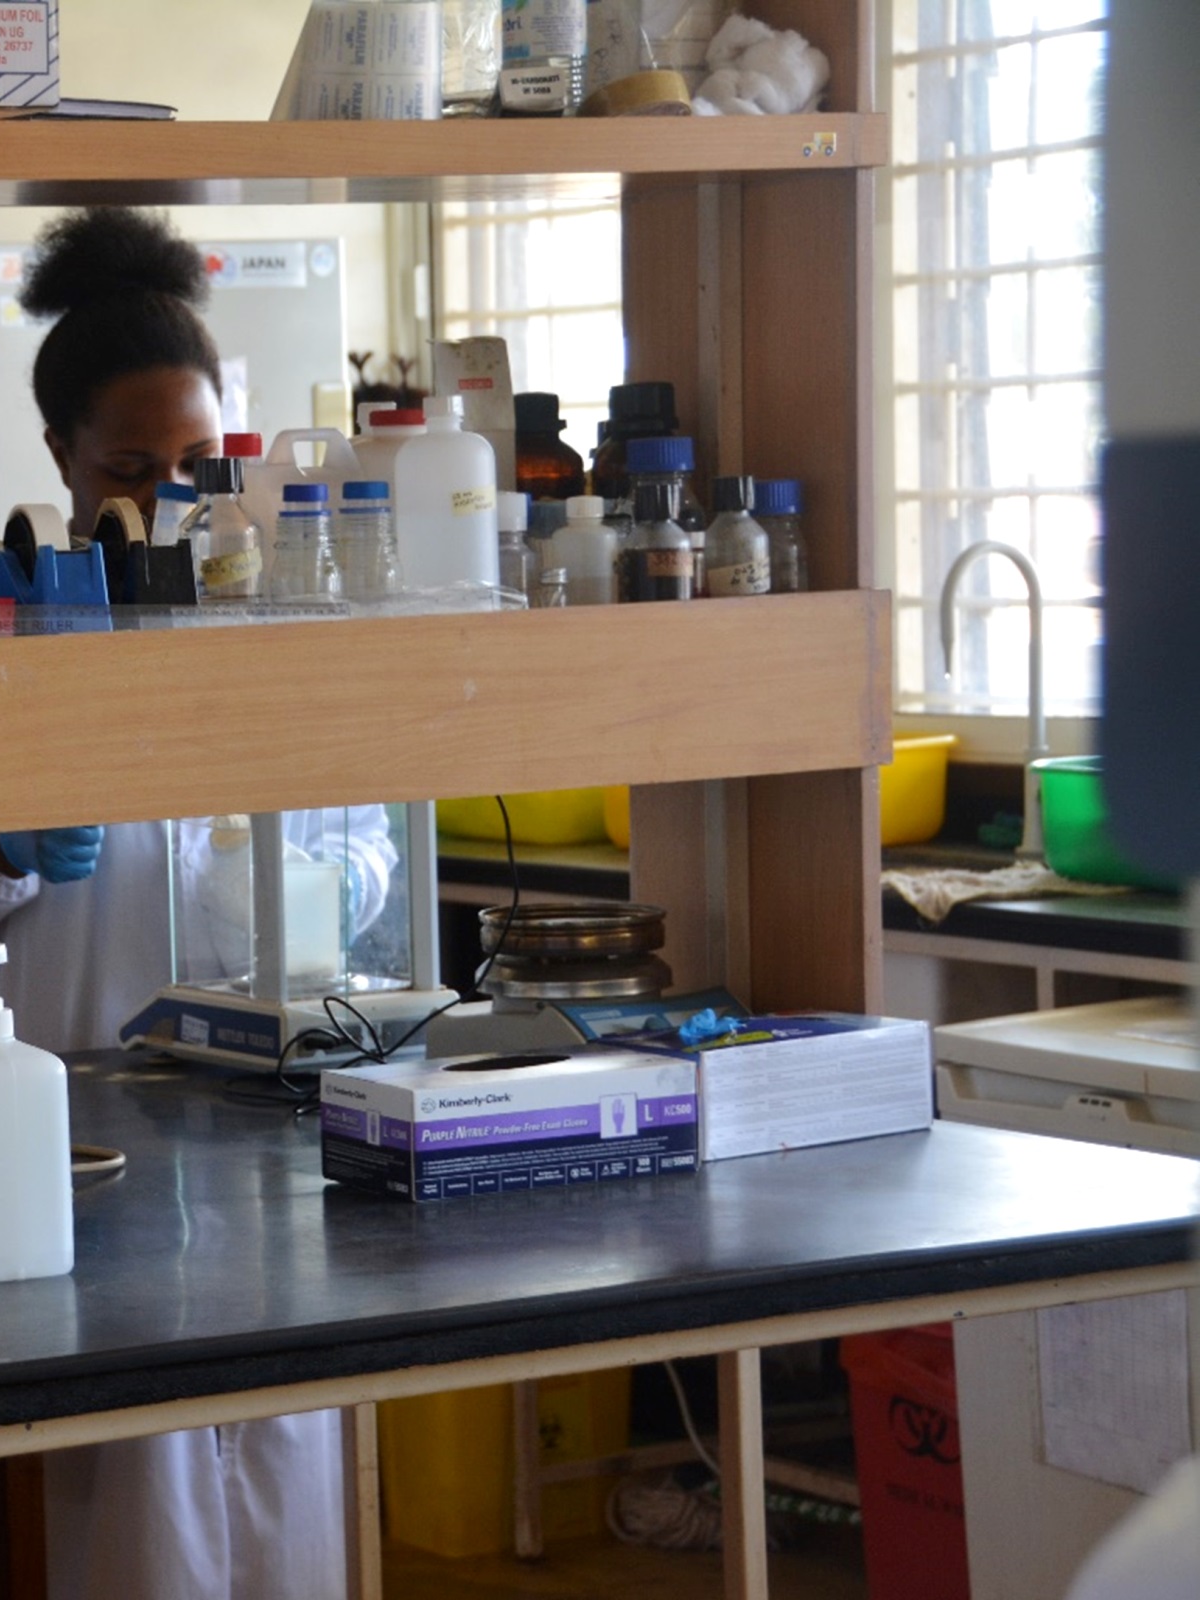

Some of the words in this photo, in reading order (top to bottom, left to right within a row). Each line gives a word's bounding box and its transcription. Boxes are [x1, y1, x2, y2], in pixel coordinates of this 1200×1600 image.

[20, 10, 44, 23] FOIL
[9, 27, 24, 38] UG
[242, 256, 285, 270] JAPAN
[32, 620, 74, 633] RULER
[439, 1093, 512, 1108] Kimberly-Clark
[645, 1104, 654, 1121] L
[664, 1103, 692, 1116] KC500
[421, 1129, 453, 1142] PURPLE
[455, 1126, 489, 1139] NITRILE
[493, 1122, 540, 1135] Powder-Free
[542, 1120, 562, 1131] Exam
[563, 1119, 588, 1128] Gloves
